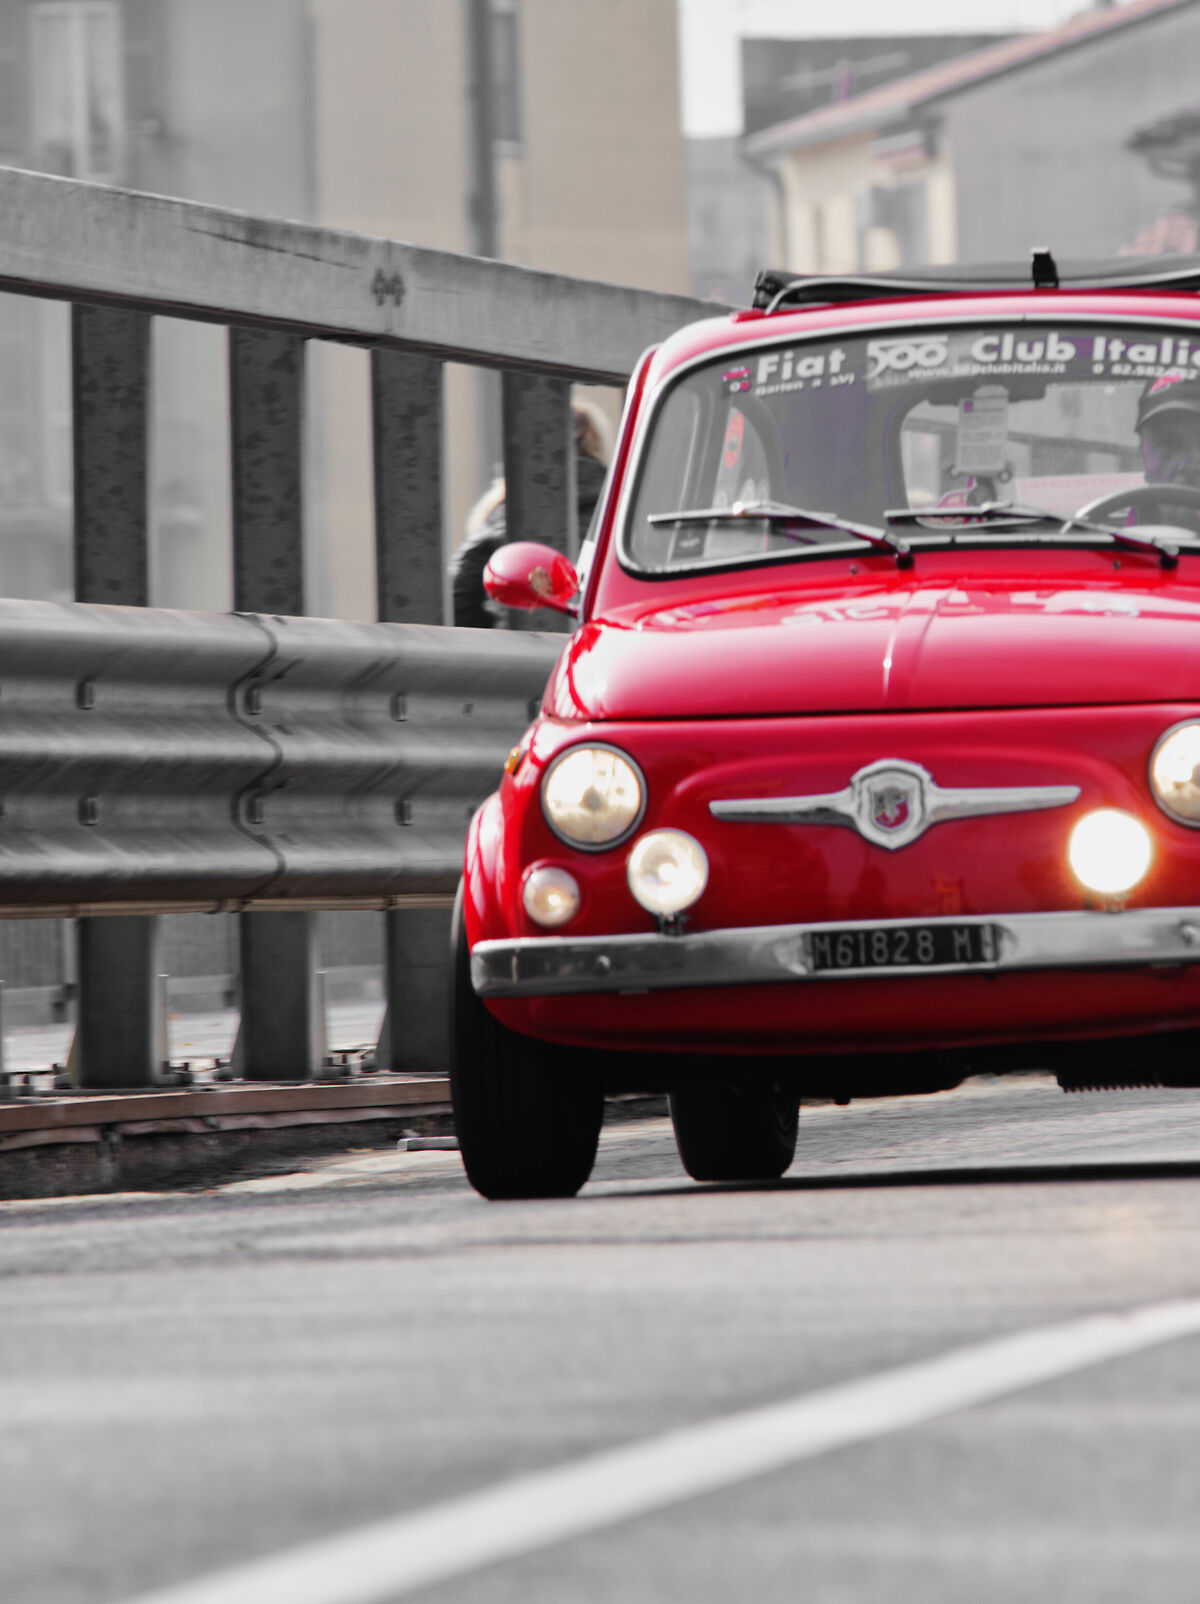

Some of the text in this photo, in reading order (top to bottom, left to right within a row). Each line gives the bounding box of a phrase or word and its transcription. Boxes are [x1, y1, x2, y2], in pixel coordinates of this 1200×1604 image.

[757, 348, 845, 384] Fiat
[865, 334, 948, 378] 500
[971, 332, 1076, 363] Club
[813, 929, 935, 967] M61828
